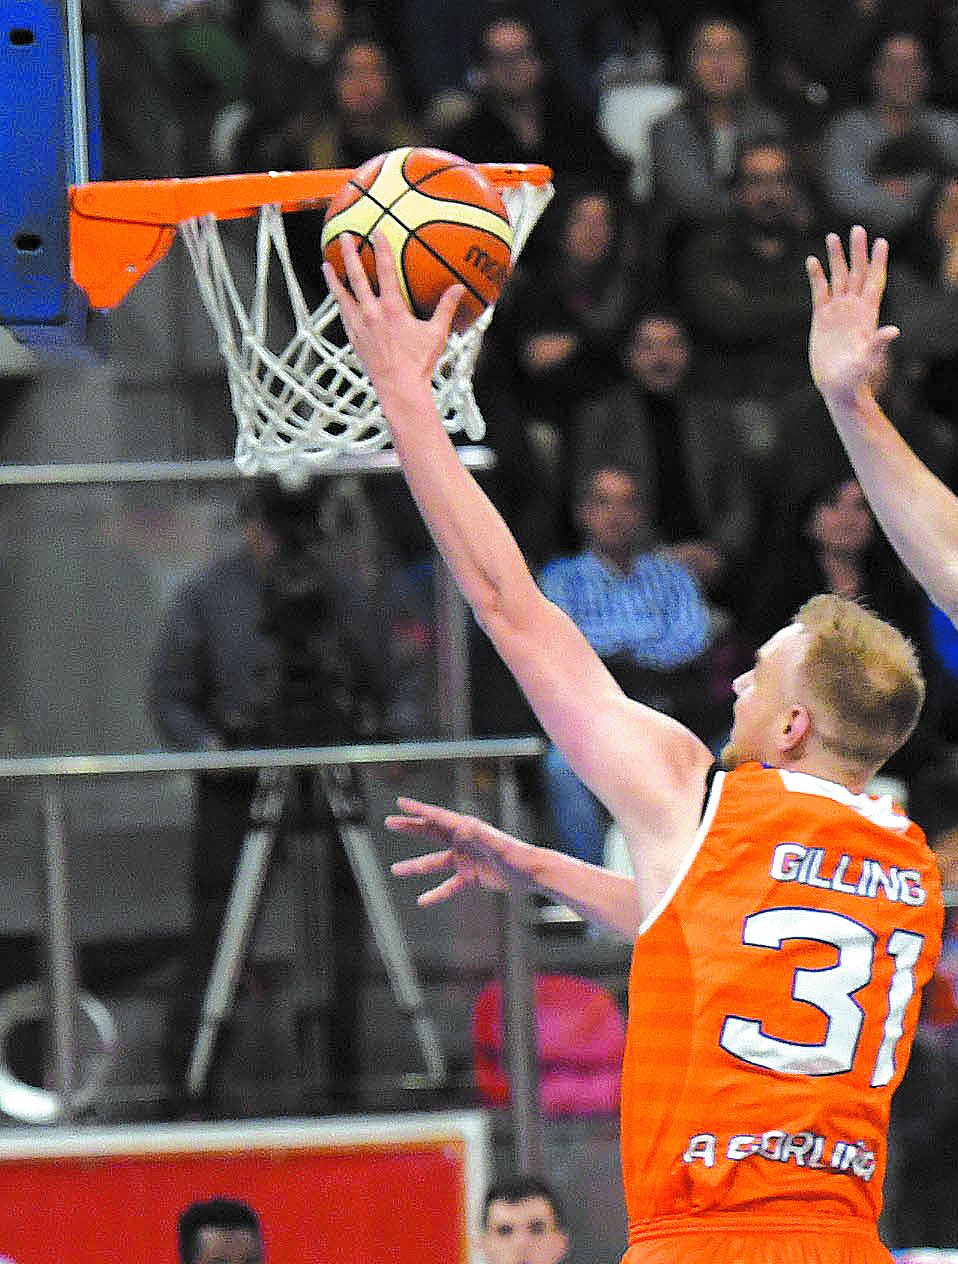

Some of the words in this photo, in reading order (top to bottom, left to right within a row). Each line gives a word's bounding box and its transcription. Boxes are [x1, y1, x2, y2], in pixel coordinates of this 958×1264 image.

[771, 842, 926, 906] GILLING
[719, 907, 924, 1087] 31
[682, 1132, 717, 1168] A
